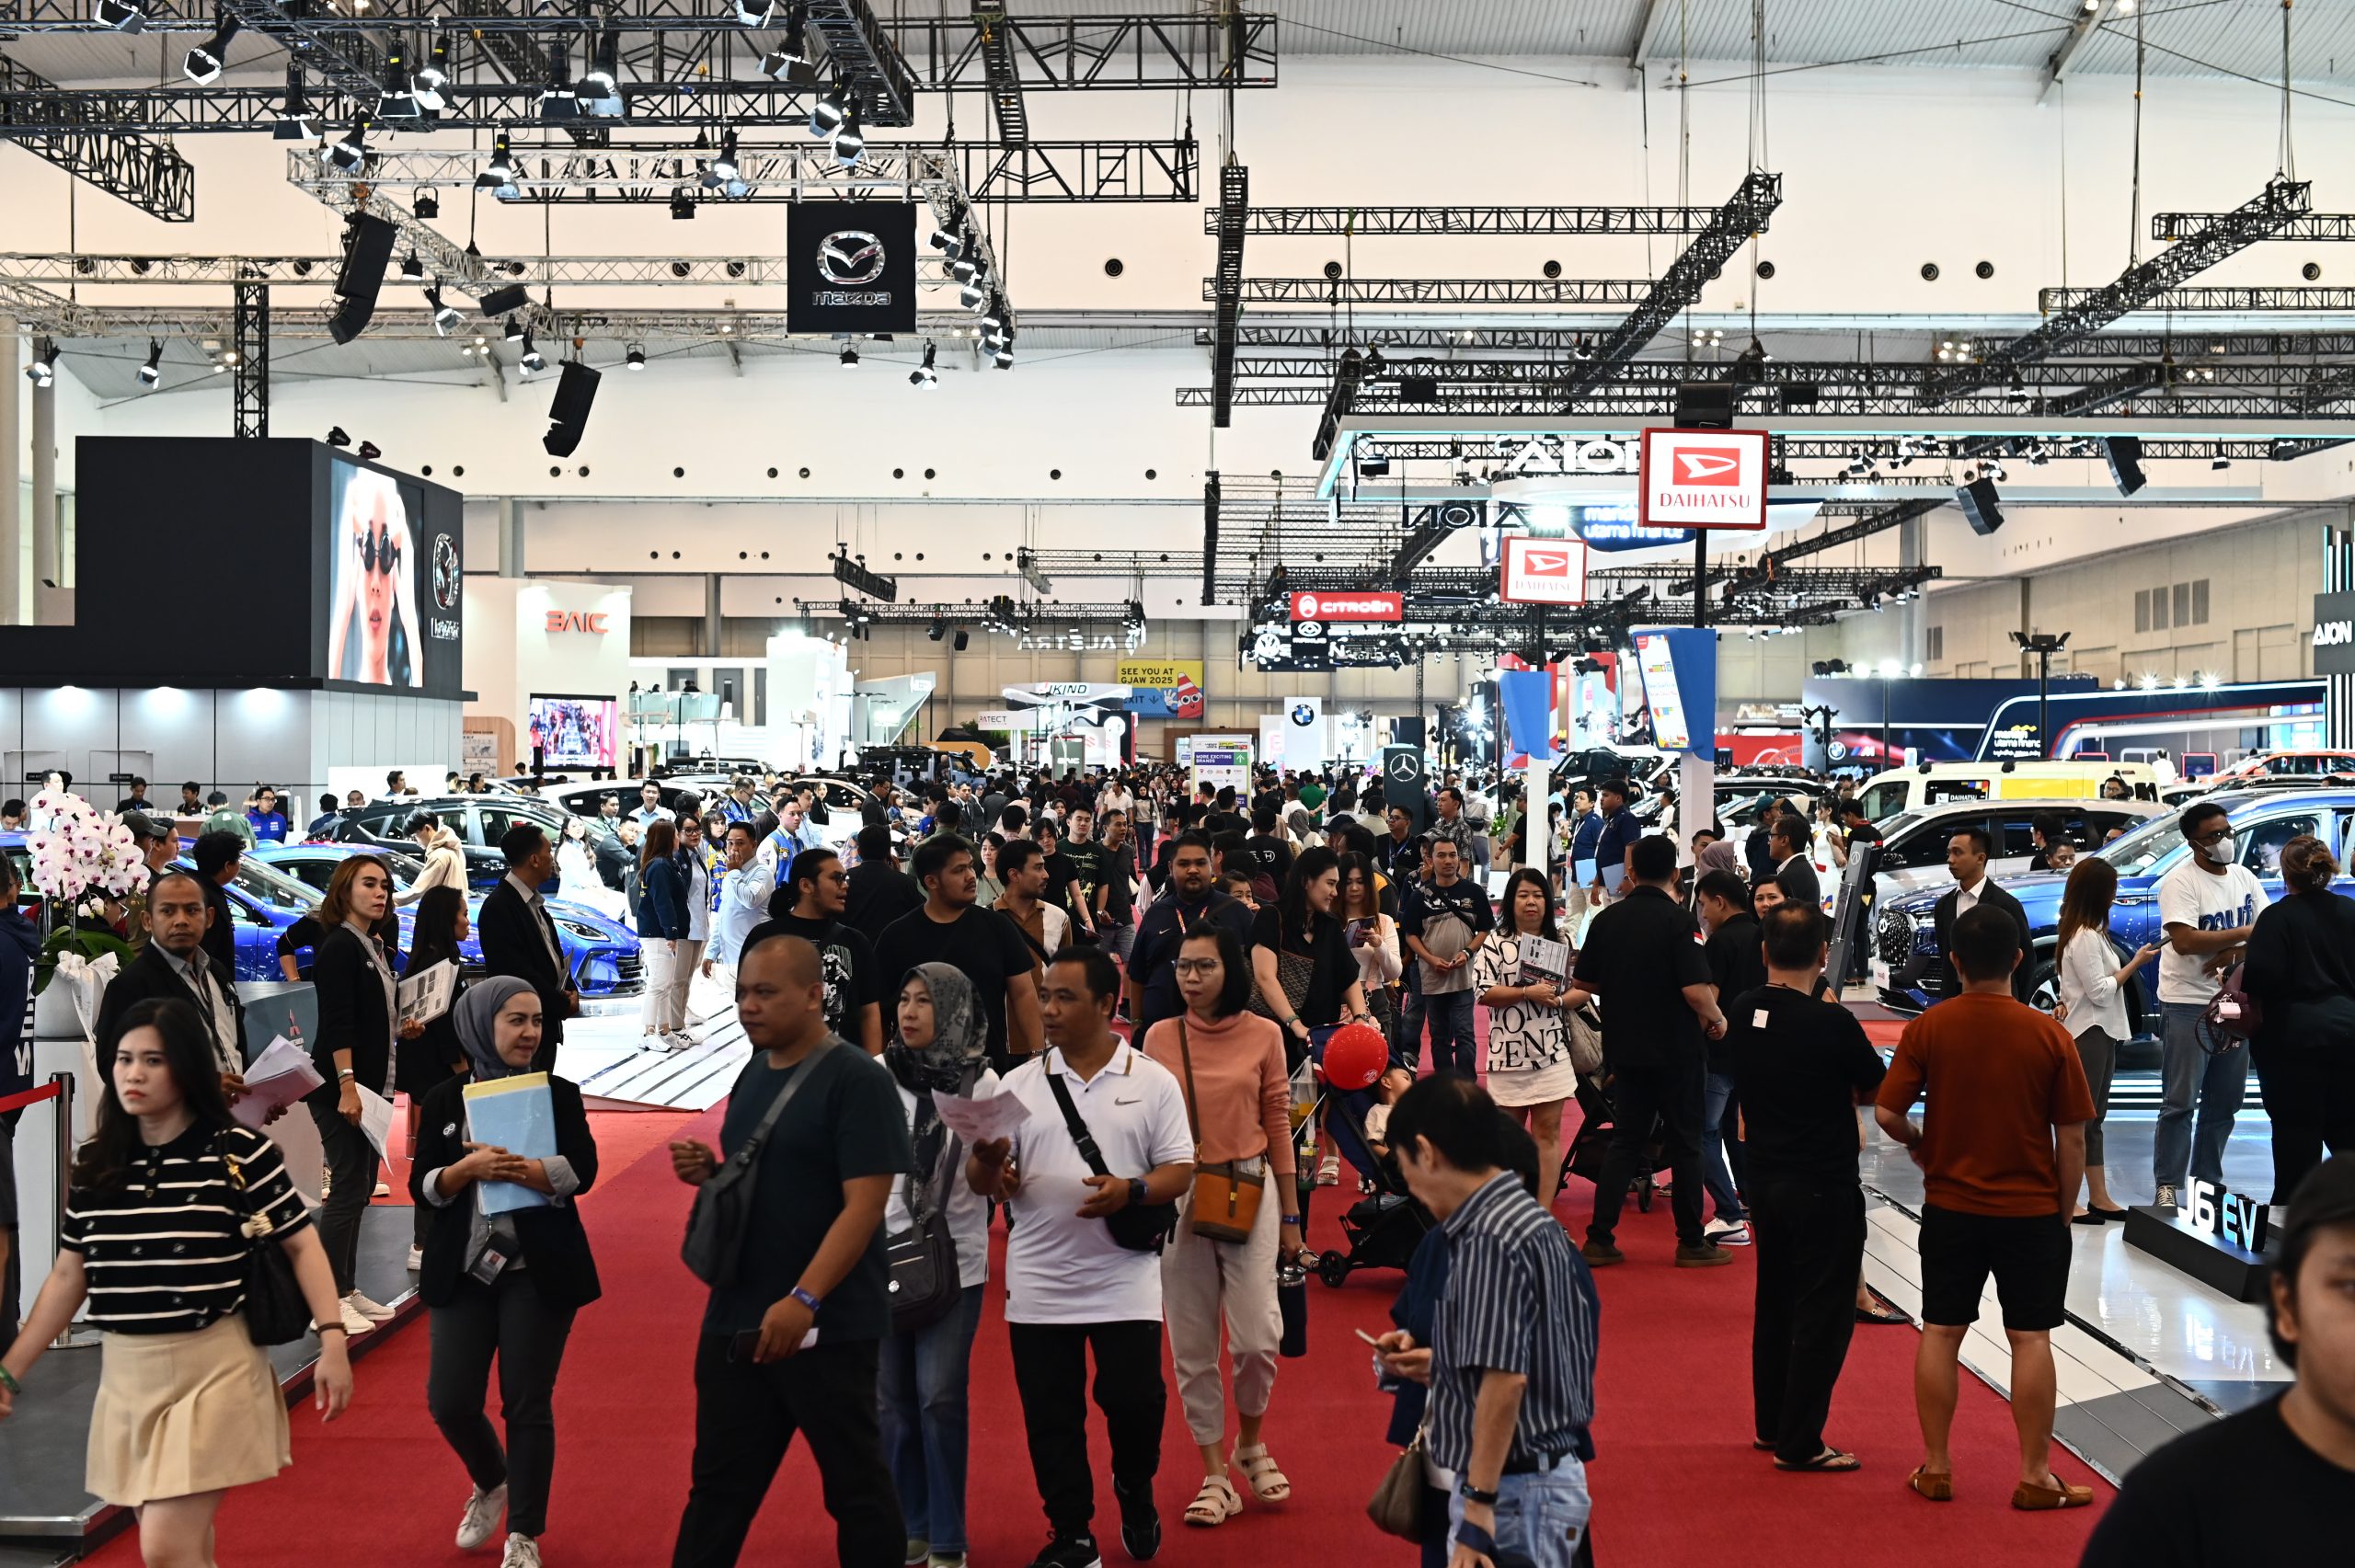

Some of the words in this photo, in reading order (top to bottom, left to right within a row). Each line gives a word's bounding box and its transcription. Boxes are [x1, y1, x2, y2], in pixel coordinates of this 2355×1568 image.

[1660, 493, 1750, 509] DAIHATSU
[1515, 580, 1573, 590] DAIHATSU
[546, 610, 609, 634] BAIC
[2312, 621, 2352, 646] AION
[1120, 676, 1146, 684] GJAW
[1149, 676, 1173, 684] 2025
[2177, 1175, 2215, 1234] J6
[2222, 1192, 2257, 1252] EV
